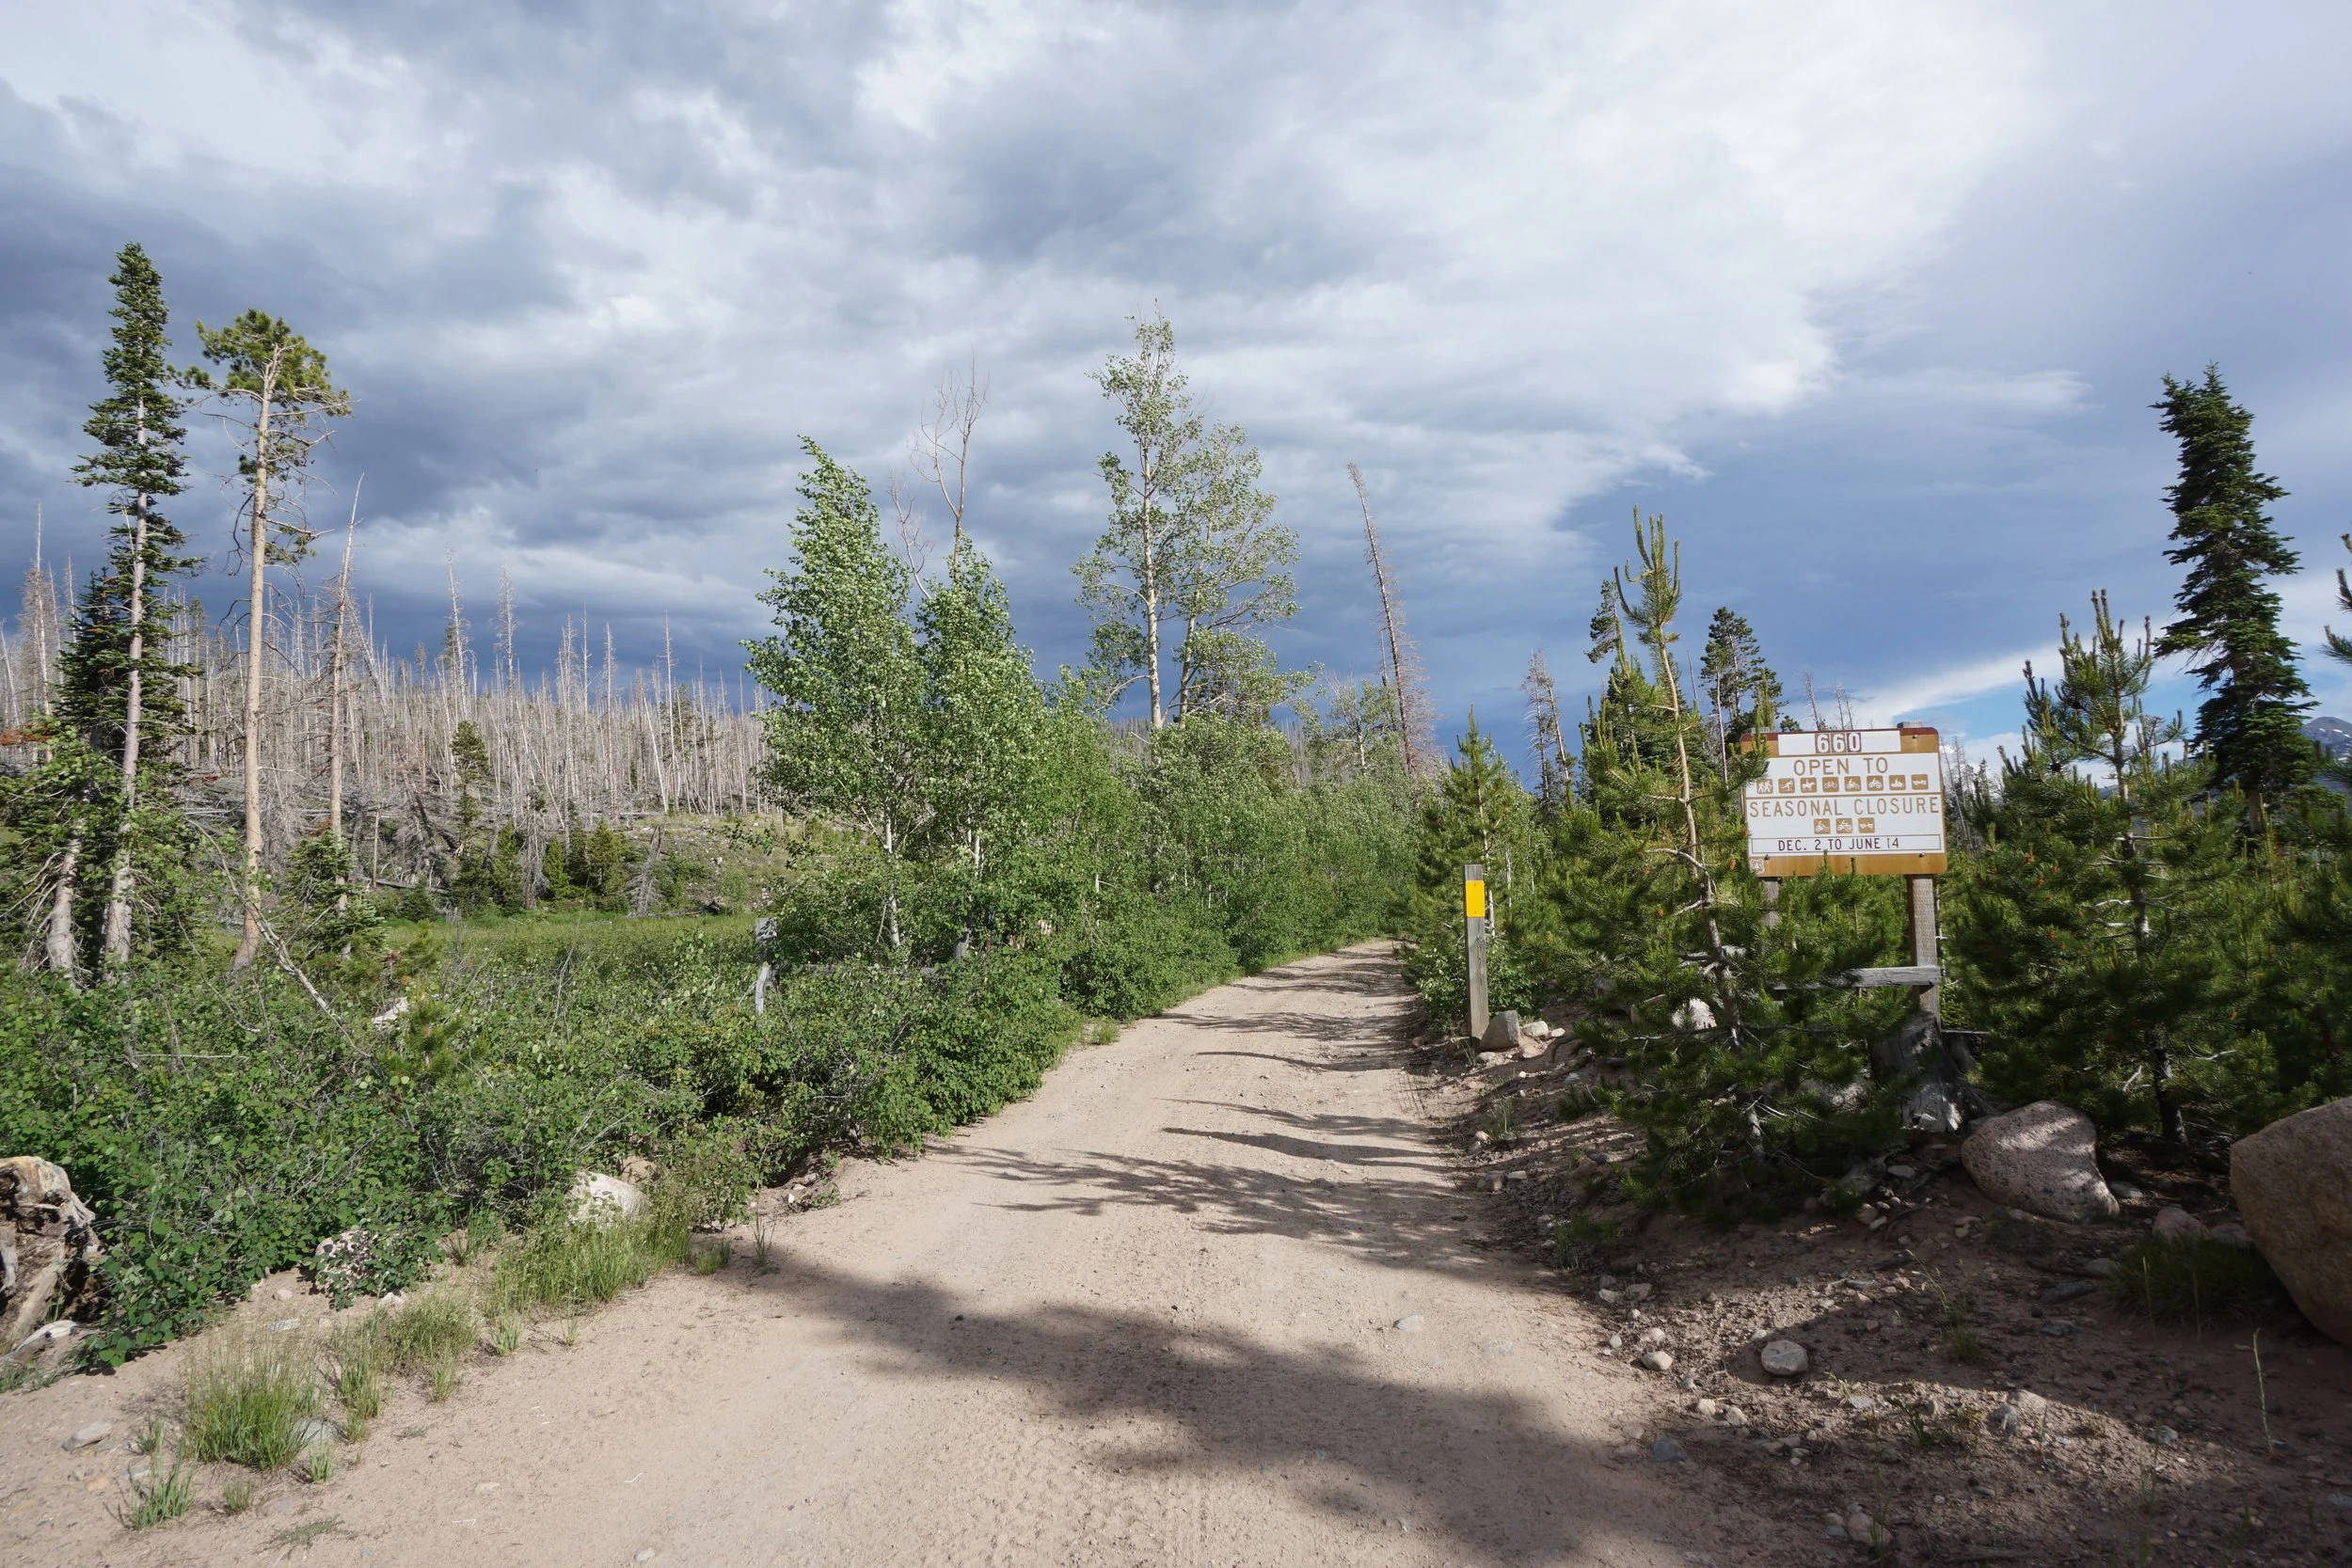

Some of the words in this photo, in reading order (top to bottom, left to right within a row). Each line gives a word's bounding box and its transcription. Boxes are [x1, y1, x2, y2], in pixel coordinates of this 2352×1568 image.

[1816, 733, 1861, 752] 660
[1793, 758, 1850, 776] OPEN
[1863, 757, 1888, 774] TO
[1749, 800, 1843, 817] SEASONAL
[1853, 797, 1940, 815] CLOSURE
[1778, 839, 1807, 851] DEC.
[1814, 839, 1821, 850] 2
[1828, 838, 1843, 850] TO
[1849, 838, 1882, 850] JUNE
[1886, 837, 1899, 849] 14
